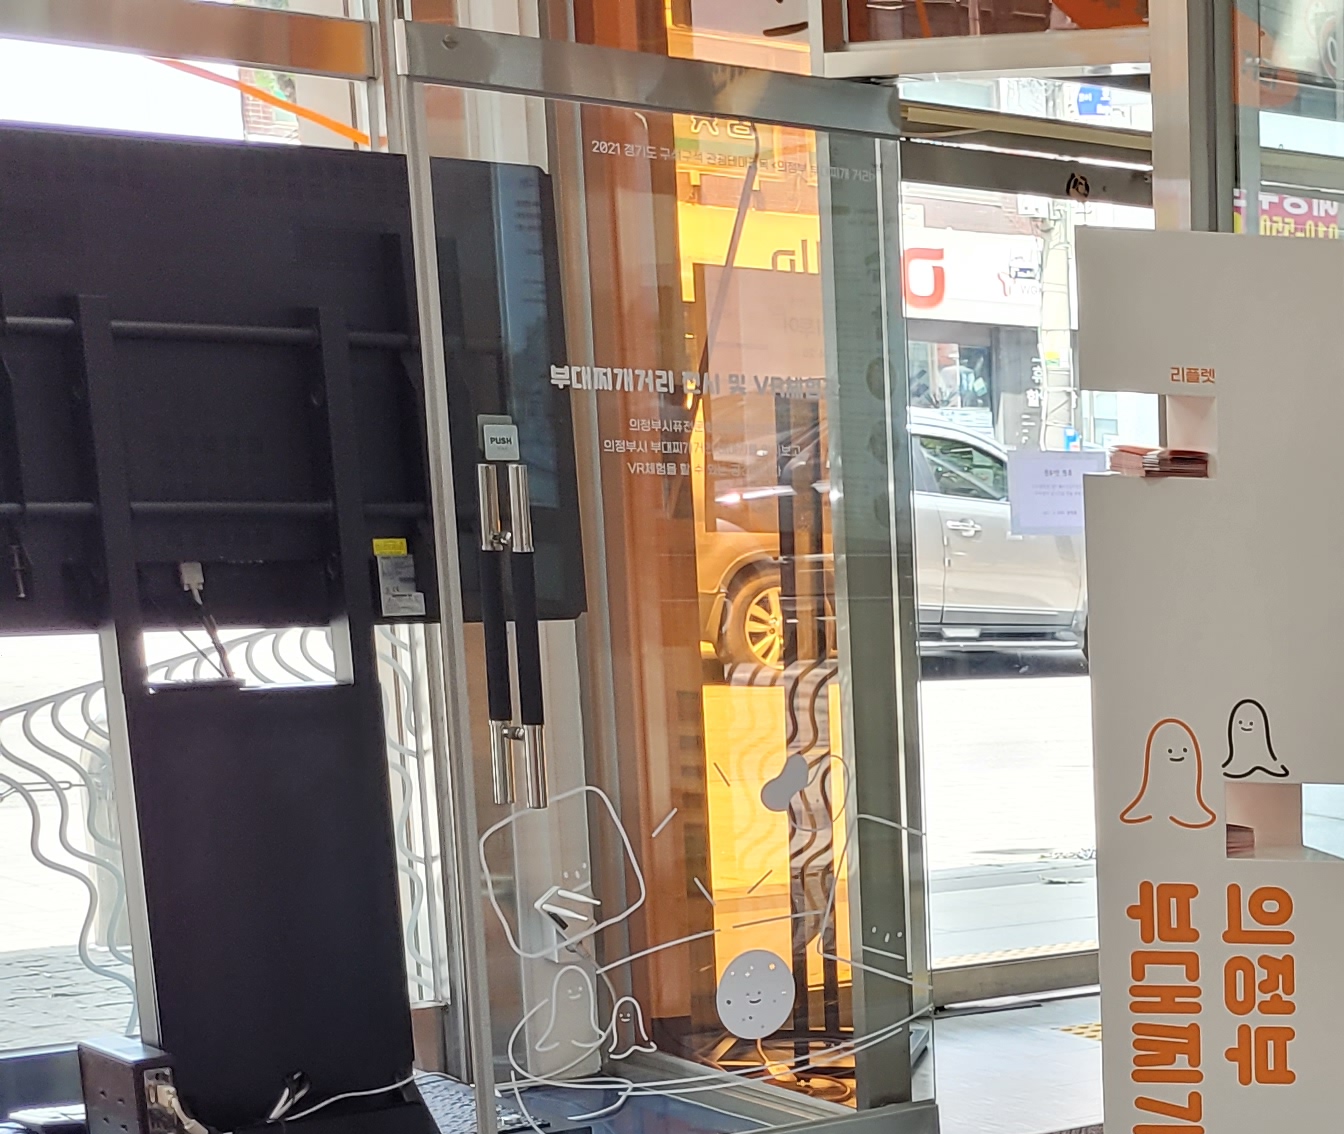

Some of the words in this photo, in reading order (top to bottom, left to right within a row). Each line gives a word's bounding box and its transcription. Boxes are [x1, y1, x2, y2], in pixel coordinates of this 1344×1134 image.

[591, 141, 620, 154] 2021
[624, 144, 656, 160] 경기도
[550, 364, 675, 394] 부대찌개거리
[1170, 366, 1216, 385] 리플렛
[490, 436, 513, 445] PUSH
[603, 439, 648, 454] 의정부시
[1222, 882, 1296, 1087] 의정부
